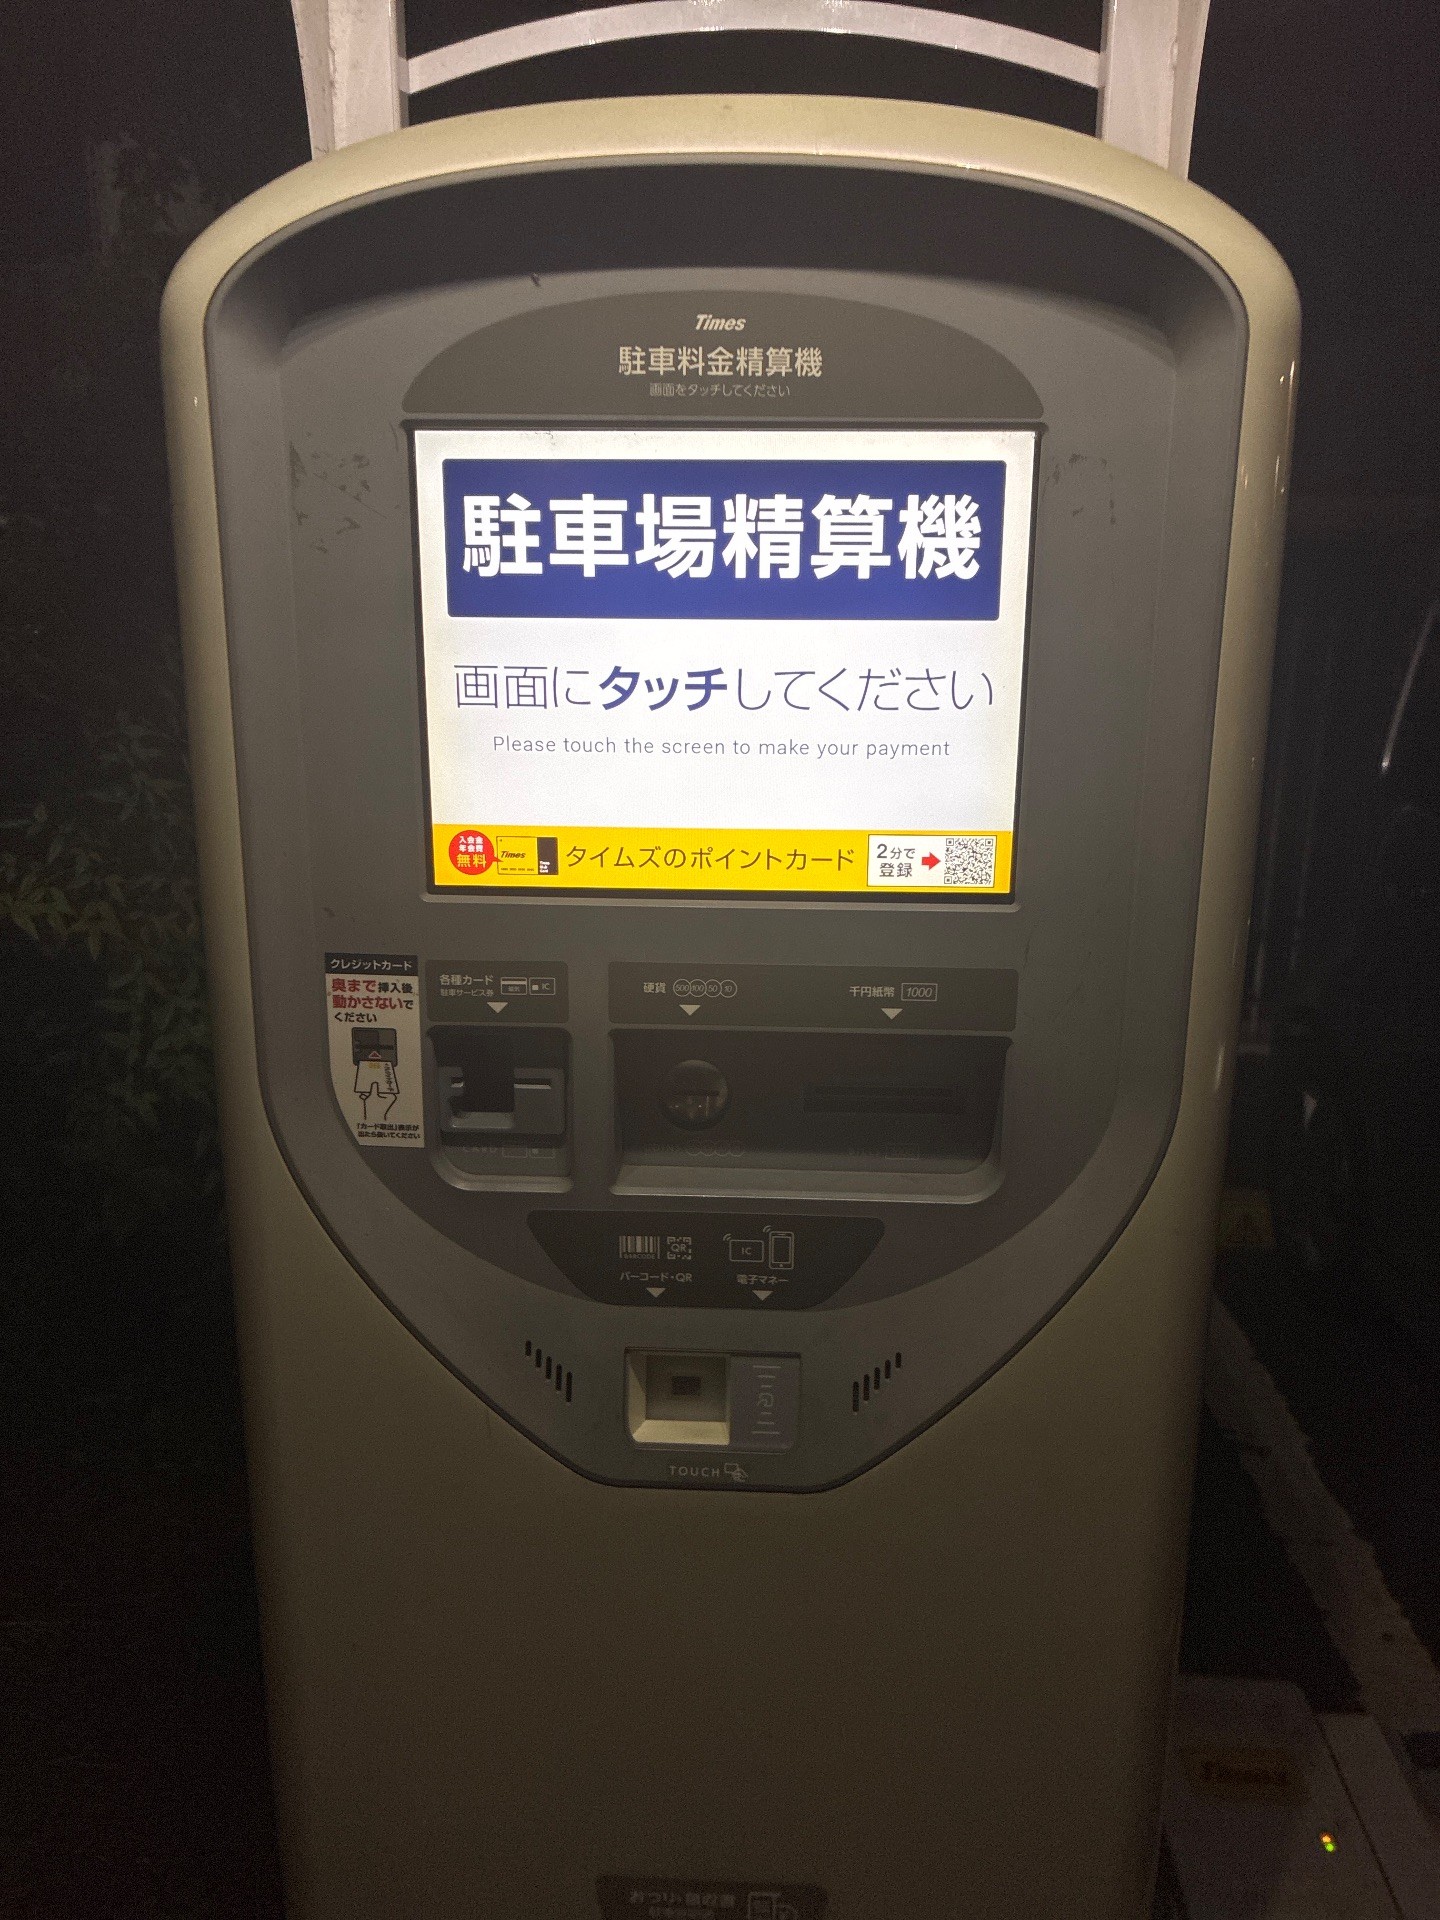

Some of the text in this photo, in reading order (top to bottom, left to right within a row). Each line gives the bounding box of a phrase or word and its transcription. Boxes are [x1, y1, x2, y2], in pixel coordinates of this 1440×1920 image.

[695, 313, 746, 331] Times
[618, 346, 823, 378] 駐車料金精算機
[650, 382, 791, 398] 画面をタッチしてください
[462, 492, 982, 580] 駐車場精算機
[454, 664, 993, 712] 画面にタッチしてください
[493, 735, 950, 760] Please touch the screen to make your payment
[876, 843, 915, 860] 2分で
[457, 854, 487, 868] 無料
[566, 845, 854, 871] タイムズのポイントカード
[879, 862, 913, 878] 登録
[330, 959, 412, 971] クレジットカード
[440, 974, 494, 986] 各種カード
[440, 988, 494, 997] 駐車サービス券
[541, 982, 551, 991] IC
[643, 982, 667, 994] 硬貨
[675, 984, 689, 992] 500
[692, 984, 705, 992] 100
[708, 984, 718, 993] 50
[849, 986, 896, 998] 千円紙幣
[906, 987, 933, 998] 1000
[332, 995, 414, 1010] 動かさないで
[334, 1011, 377, 1023] ください
[671, 1243, 687, 1252] QR
[741, 1246, 753, 1256] IC
[620, 1271, 694, 1283] バーコード・QR
[736, 1273, 790, 1285] 電子マネー
[669, 1465, 720, 1478] TOUCH
